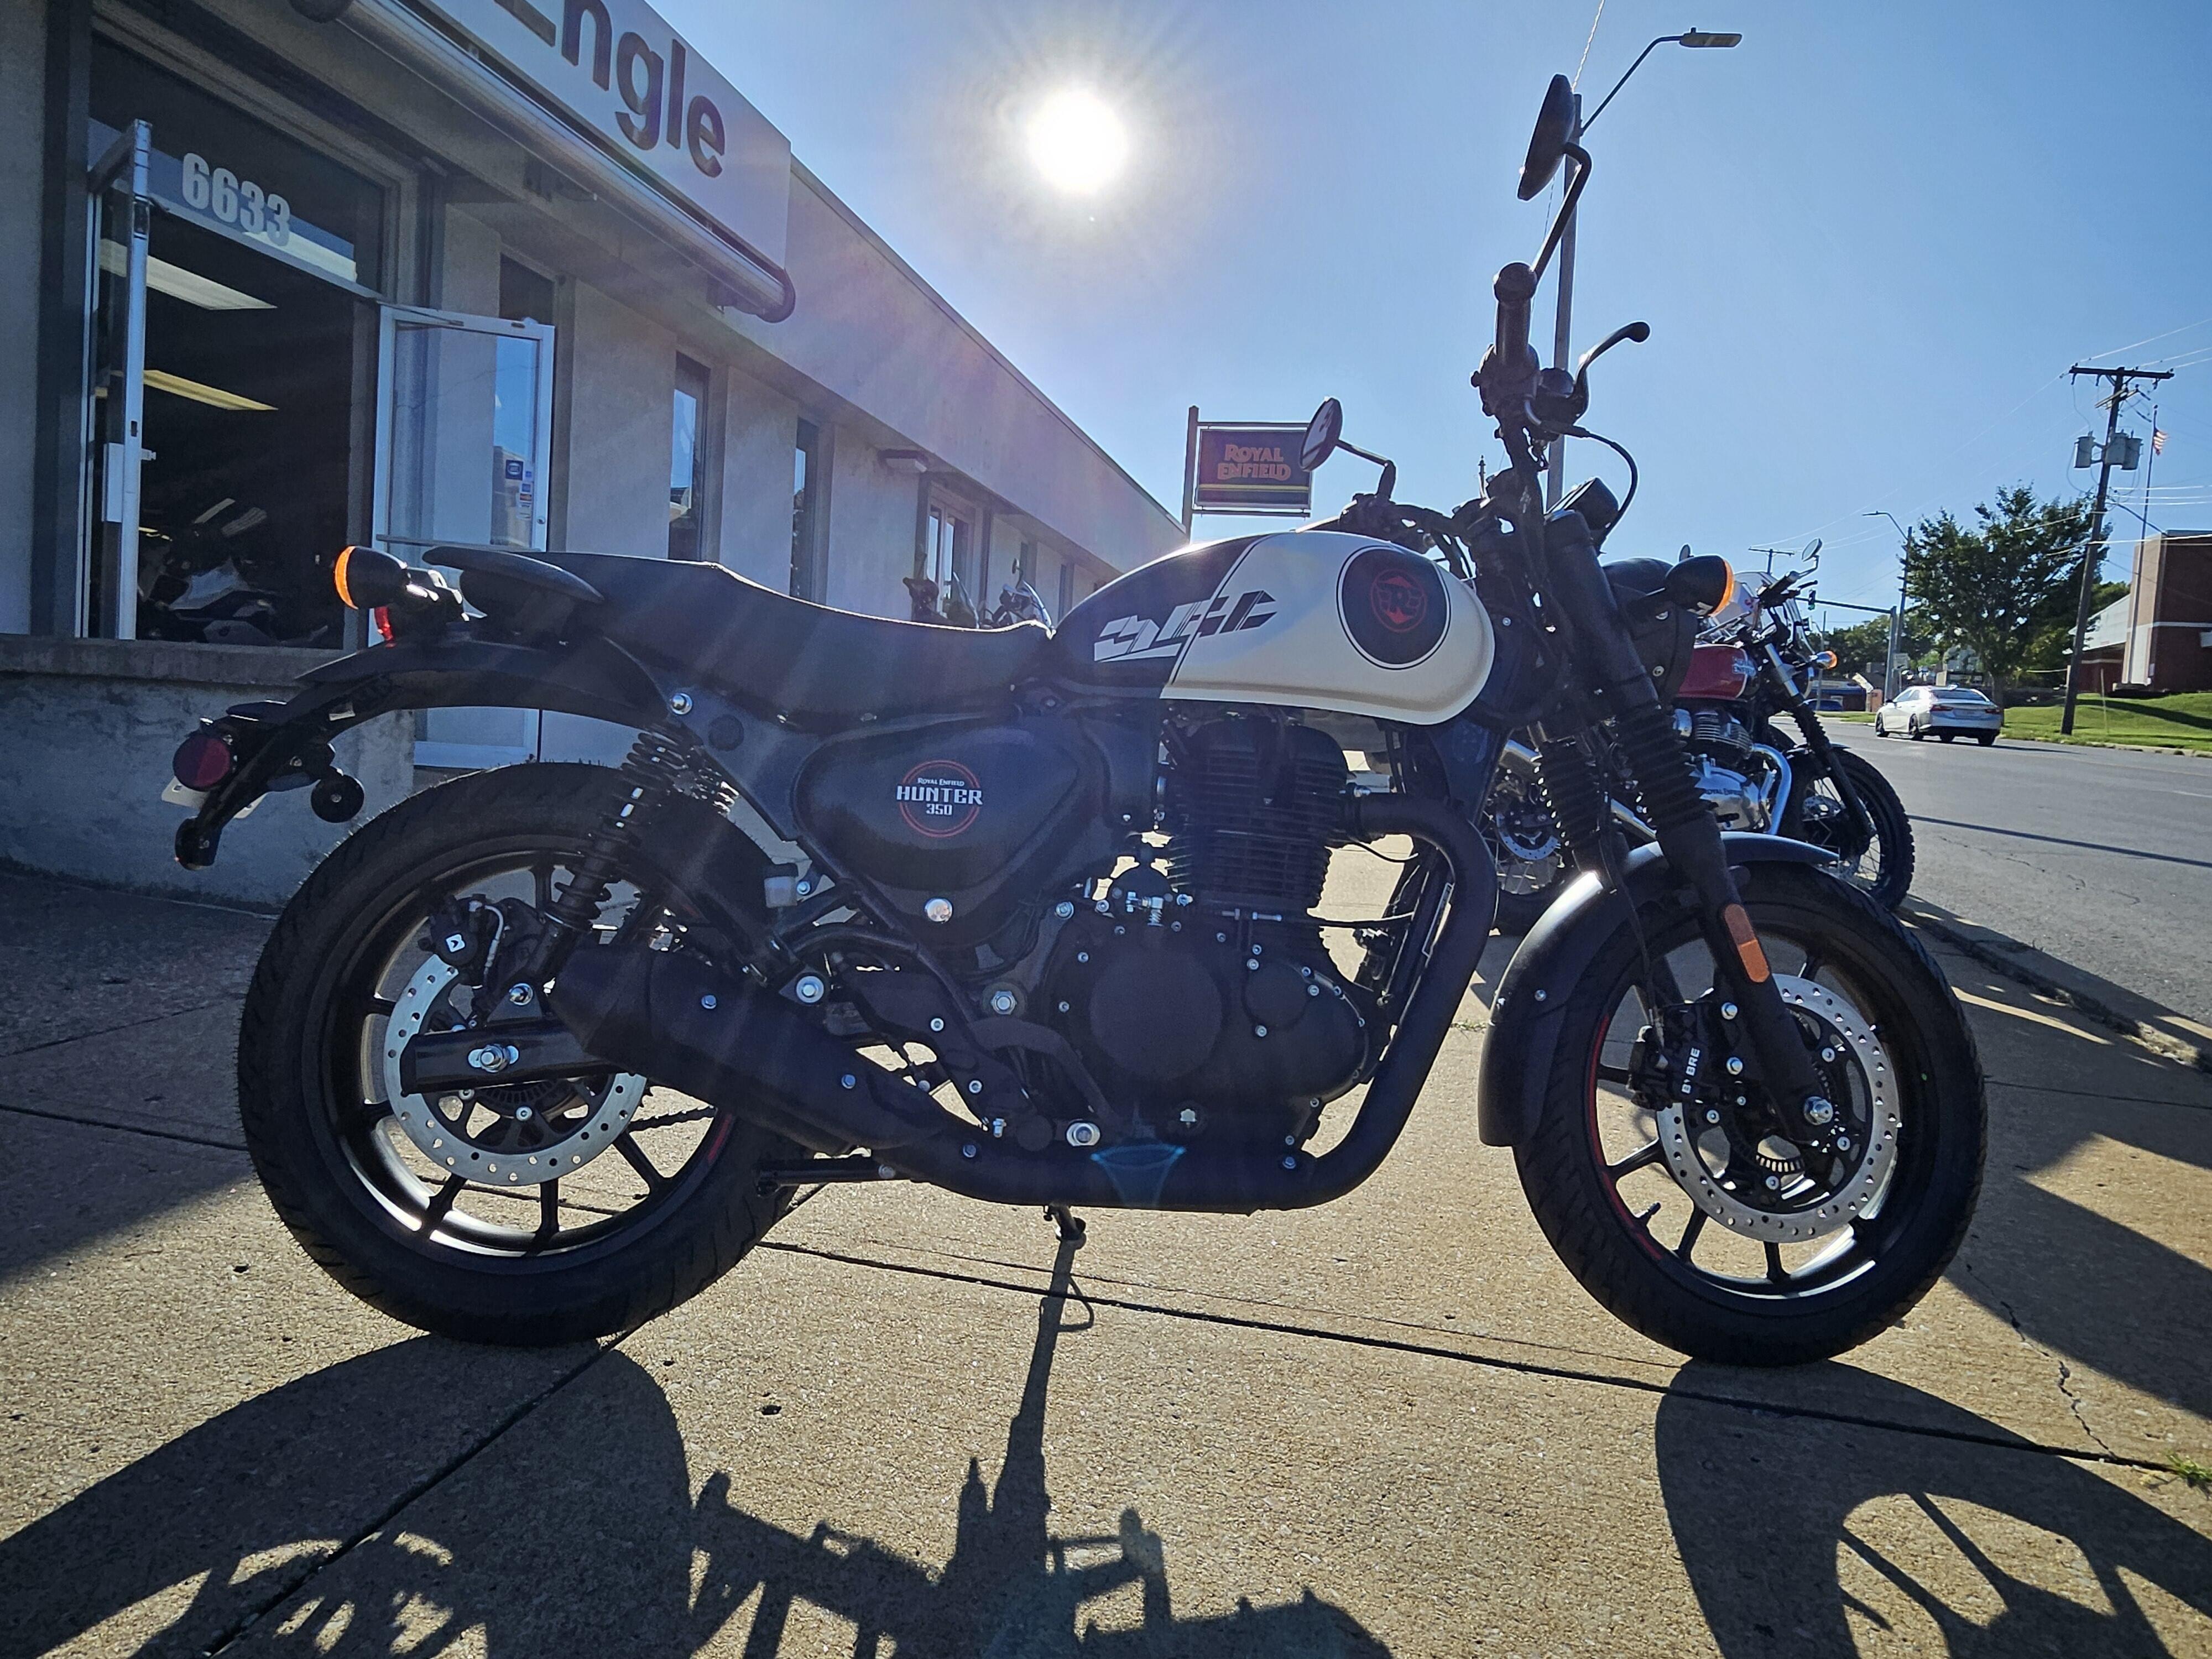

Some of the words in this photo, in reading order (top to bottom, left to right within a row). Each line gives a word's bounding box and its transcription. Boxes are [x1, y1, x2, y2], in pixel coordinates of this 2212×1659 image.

[182, 153, 290, 247] 6633
[1224, 444, 1284, 462] ROYAL
[1218, 463, 1291, 481] ENFIELD
[896, 786, 983, 805] HUNTER
[926, 804, 952, 815] 350
